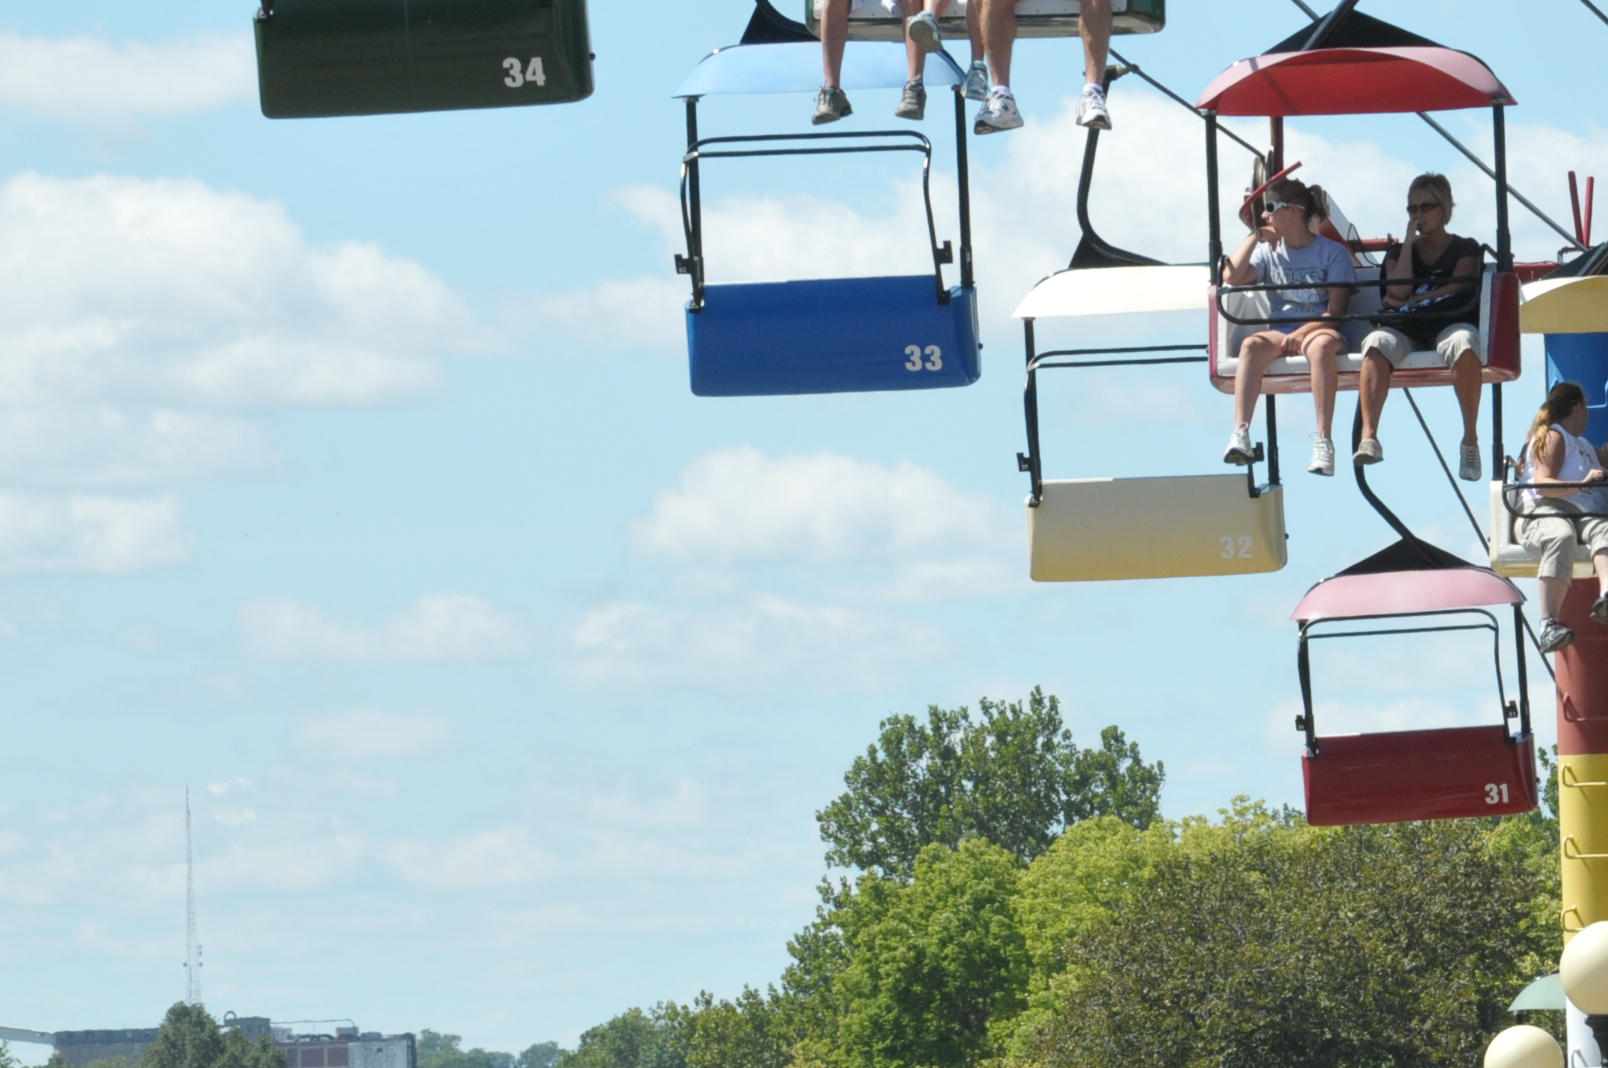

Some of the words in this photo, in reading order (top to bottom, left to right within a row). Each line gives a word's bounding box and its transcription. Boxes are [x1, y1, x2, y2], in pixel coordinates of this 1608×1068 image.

[502, 56, 546, 88] 34
[904, 344, 943, 372] 33
[1219, 536, 1253, 559] 32
[1483, 783, 1510, 805] 31
